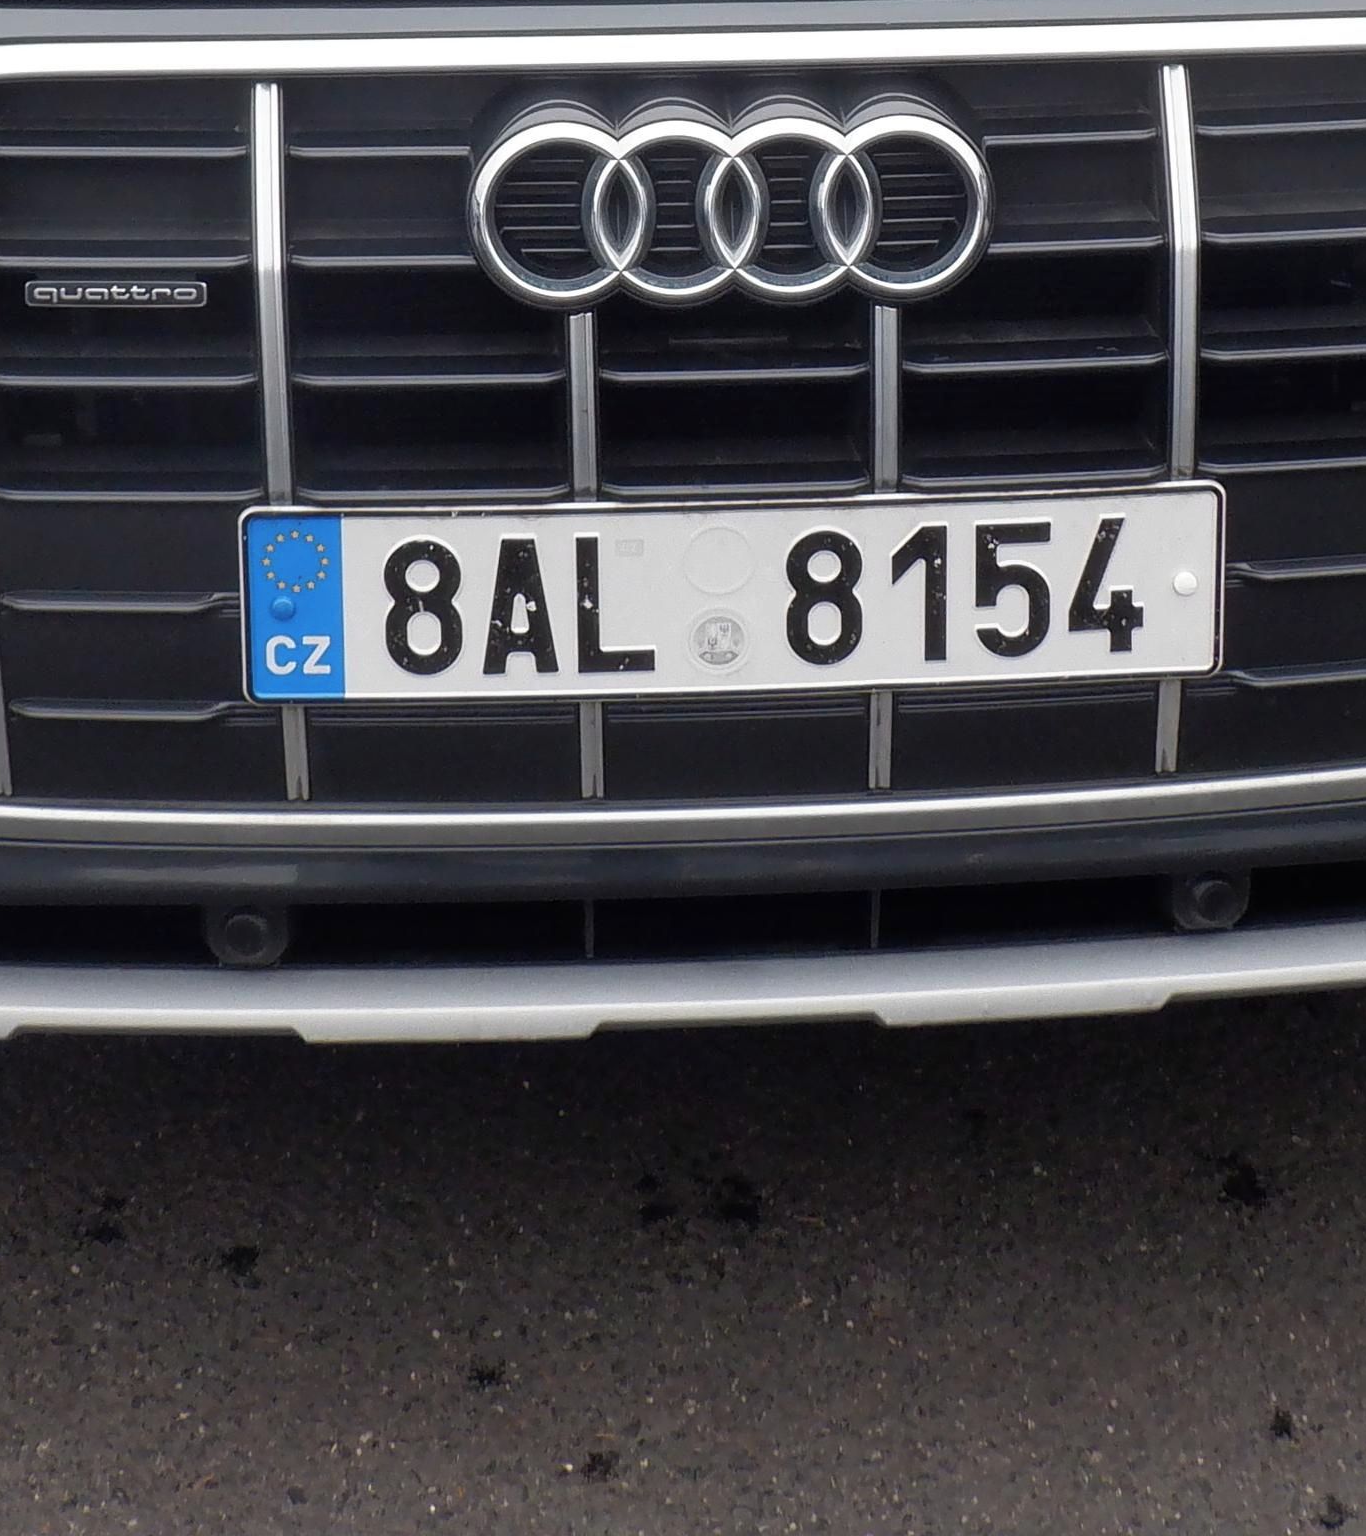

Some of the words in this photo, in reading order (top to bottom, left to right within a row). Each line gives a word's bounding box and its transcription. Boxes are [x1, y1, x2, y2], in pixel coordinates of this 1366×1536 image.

[34, 284, 197, 304] quattro
[265, 635, 332, 676] CZ
[383, 535, 657, 676] 8AL
[785, 516, 1145, 666] 8154
